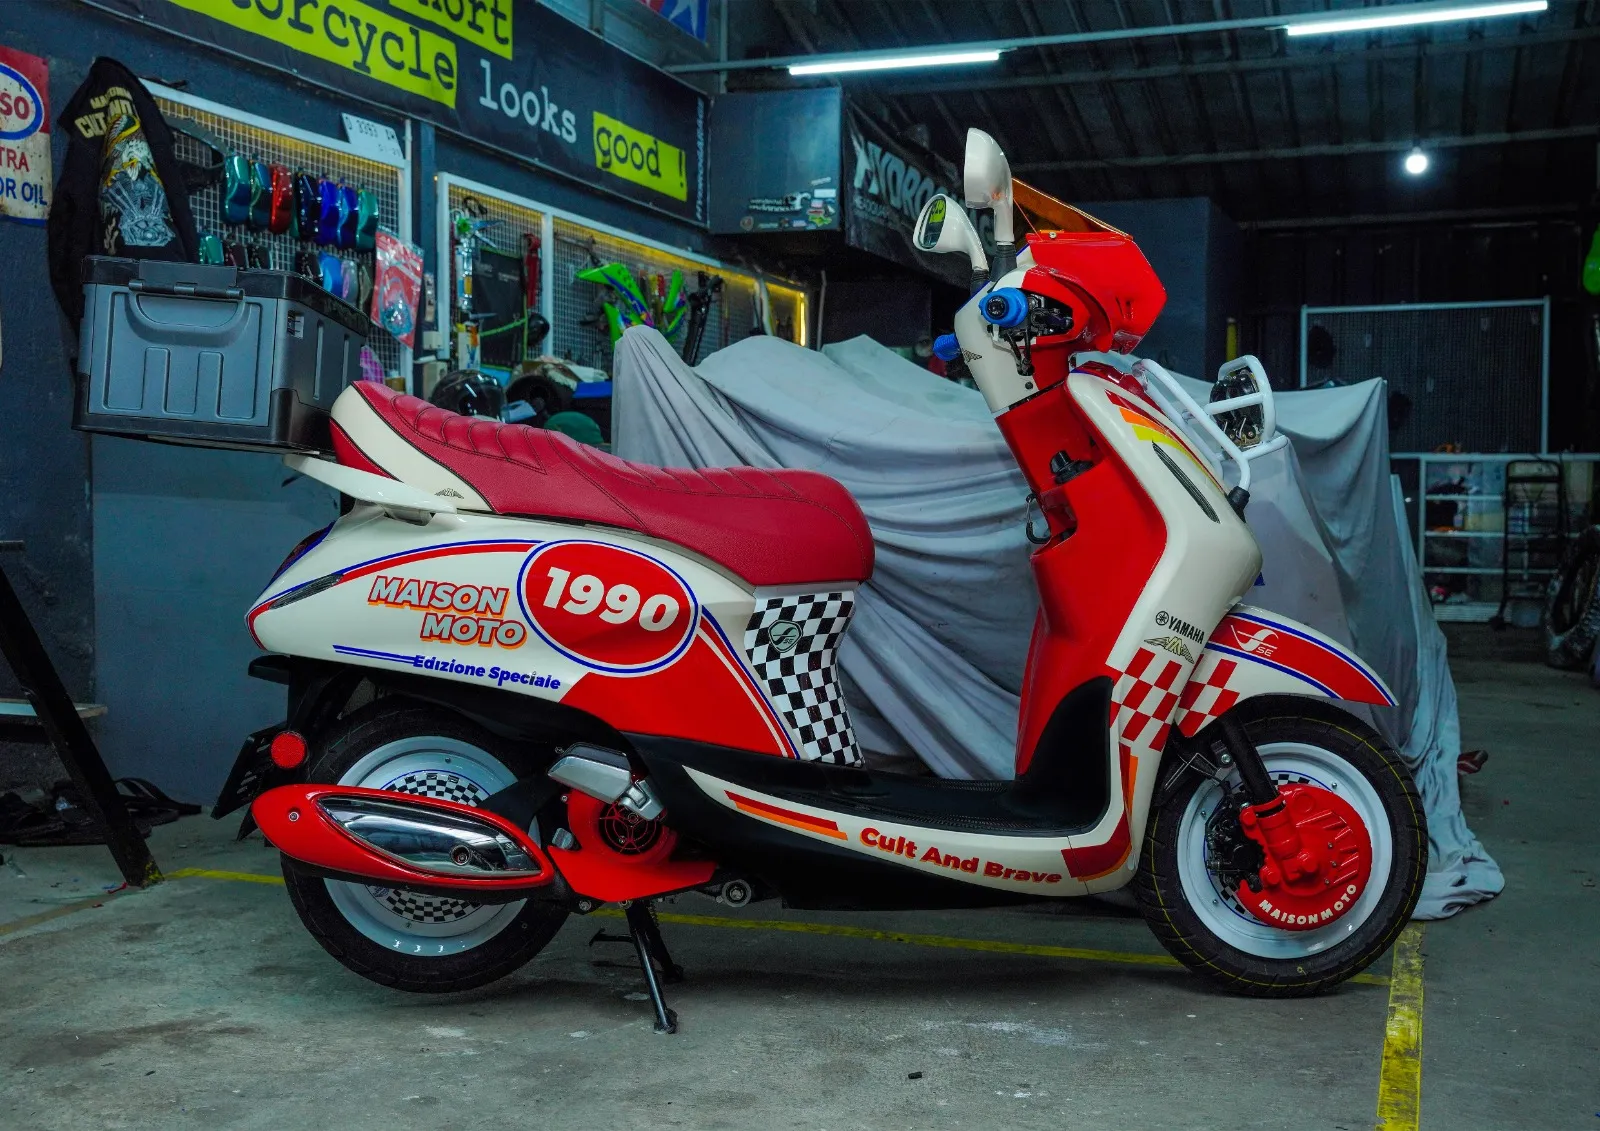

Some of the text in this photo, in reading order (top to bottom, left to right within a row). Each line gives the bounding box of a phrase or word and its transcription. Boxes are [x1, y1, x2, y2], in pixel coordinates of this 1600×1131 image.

[418, 0, 509, 45] ort
[231, 0, 454, 90] orcycle
[479, 58, 577, 144] looks
[596, 126, 662, 178] good
[21, 181, 47, 206] OIL
[368, 575, 510, 618] MAISON
[542, 566, 680, 632] 1990
[420, 612, 528, 650] MOTO
[1168, 615, 1205, 645] YAMAHA
[413, 654, 561, 690] Edizione Speciale
[1255, 646, 1274, 657] SE
[859, 827, 1062, 884] Cult And Brave
[1258, 884, 1357, 925] MAISON MOTO
